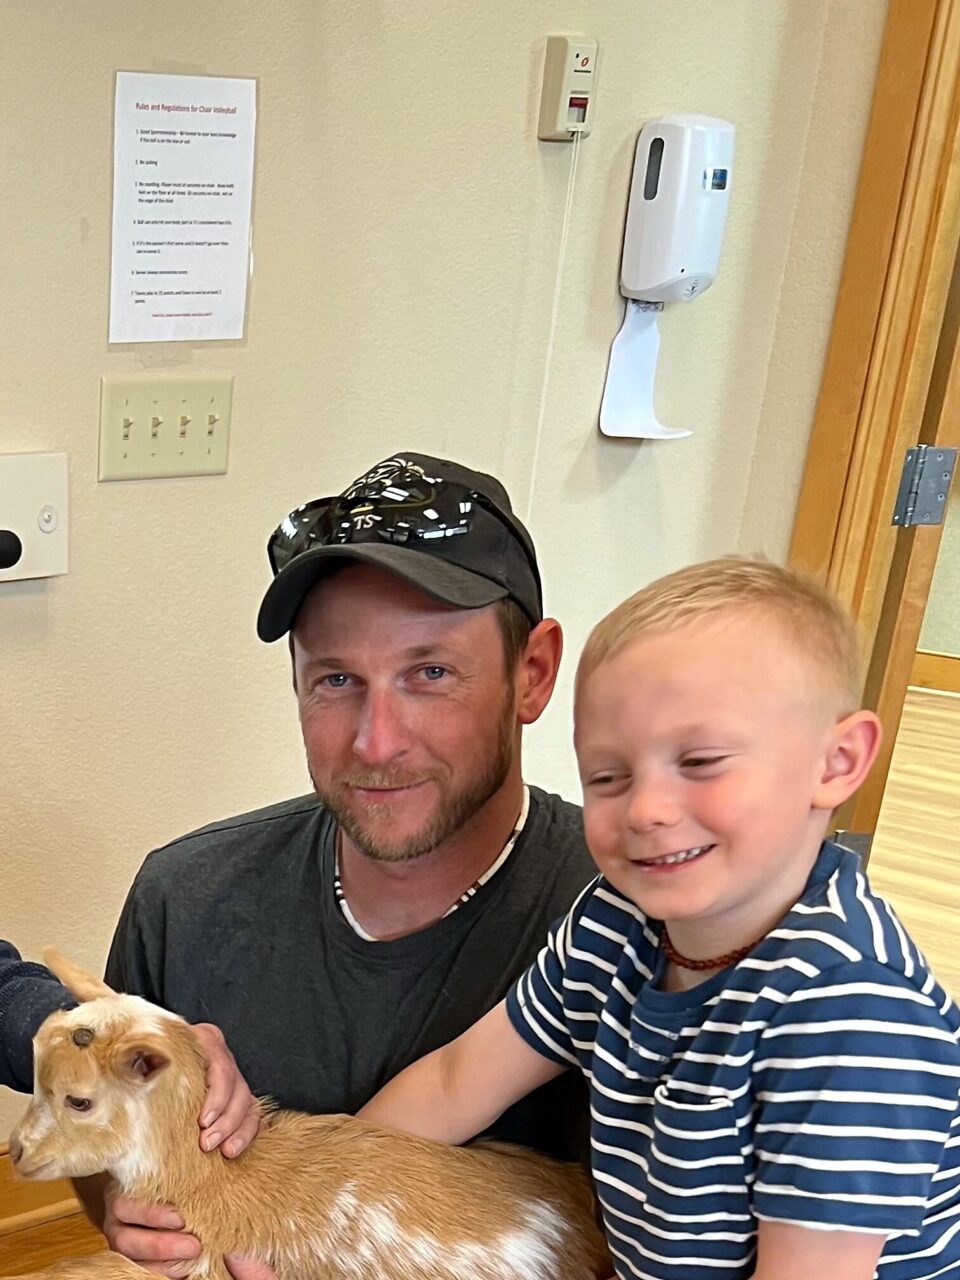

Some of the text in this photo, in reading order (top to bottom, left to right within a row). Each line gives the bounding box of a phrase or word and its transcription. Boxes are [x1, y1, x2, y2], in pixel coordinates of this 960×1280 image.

[136, 102, 150, 111] Rules
[151, 103, 160, 111] and
[162, 104, 190, 113] Regulations
